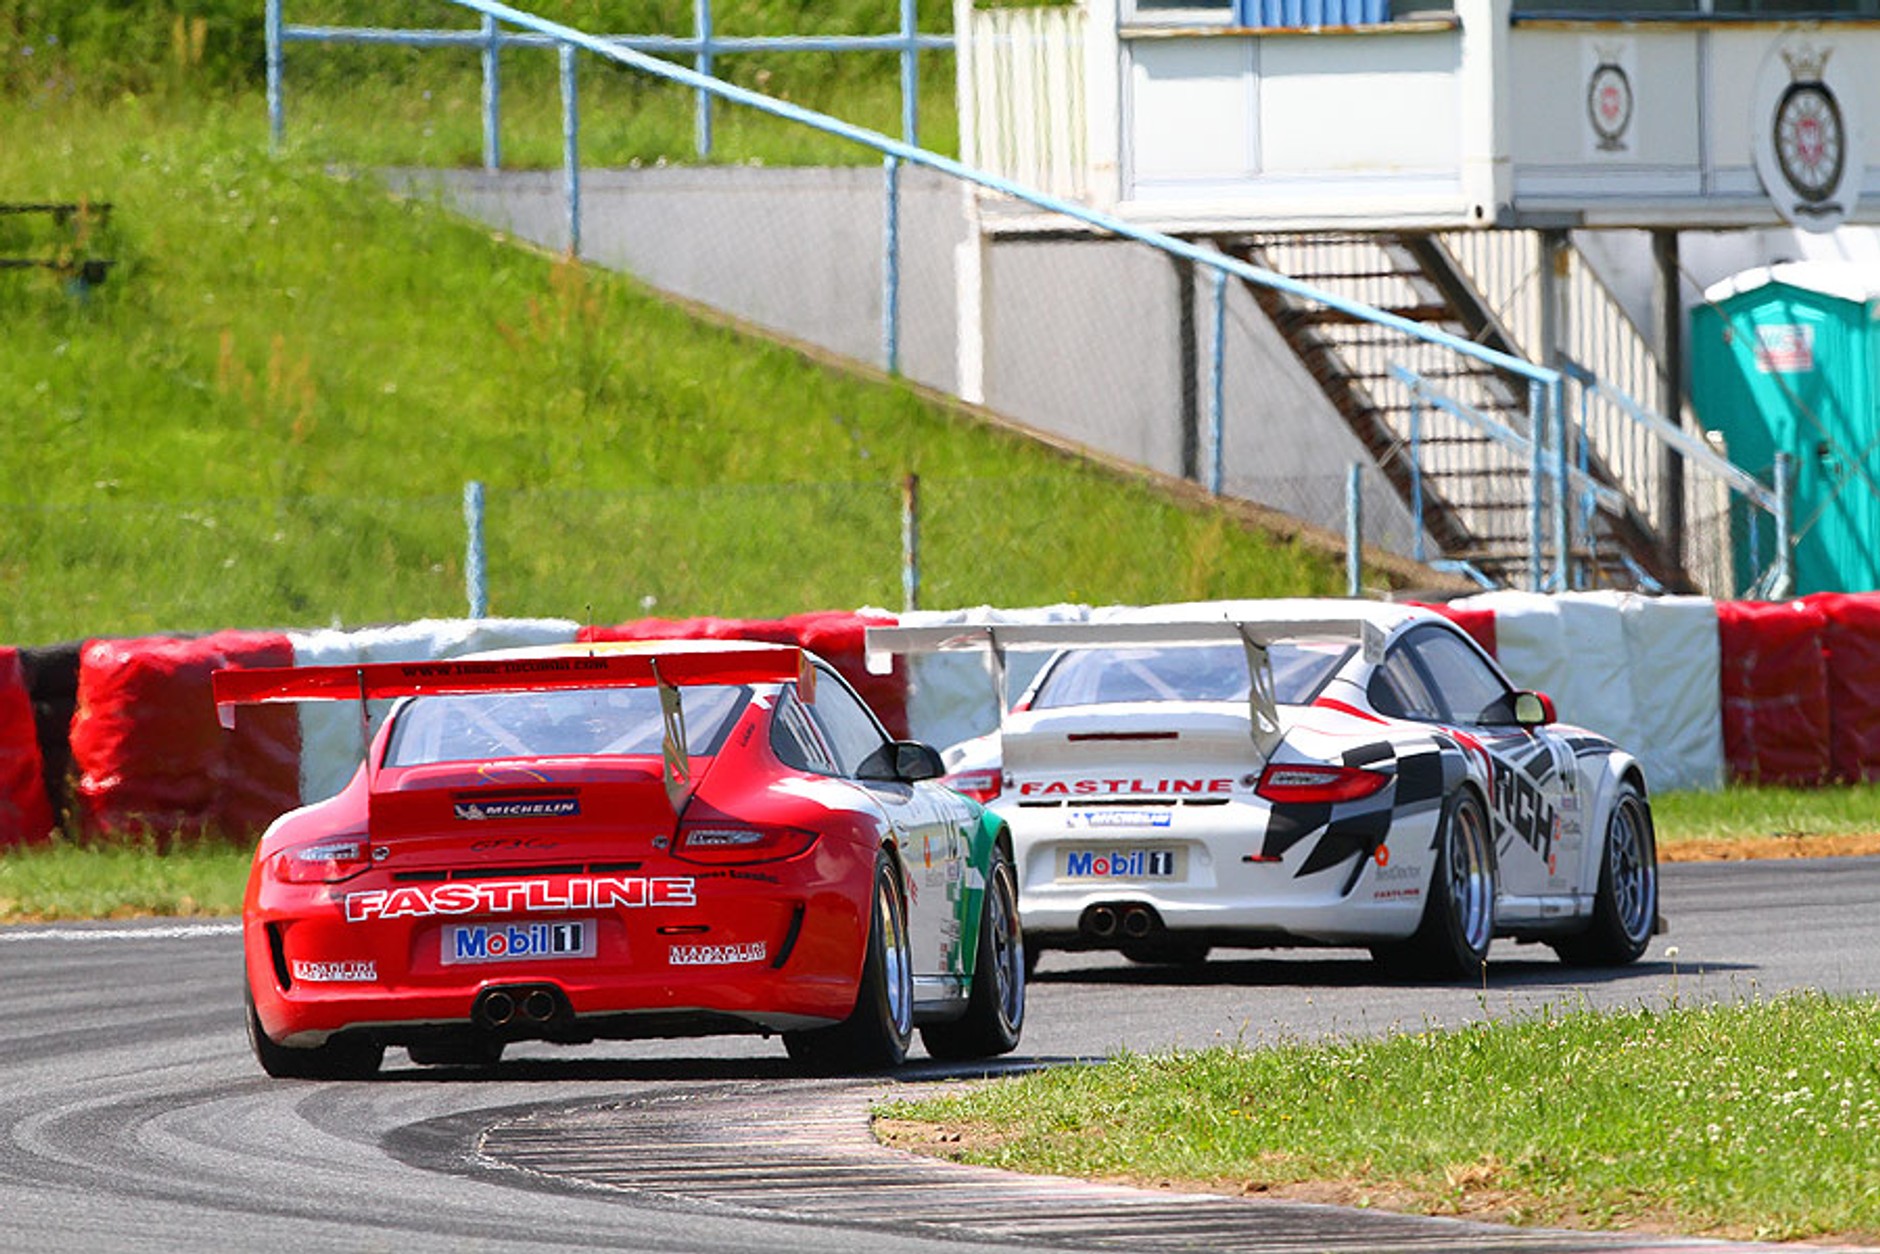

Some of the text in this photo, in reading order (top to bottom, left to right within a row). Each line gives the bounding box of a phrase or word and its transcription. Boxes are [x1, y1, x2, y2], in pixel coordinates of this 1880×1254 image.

[1019, 779, 1234, 796] FASTLINE
[486, 803, 575, 816] MICHELIN
[1067, 851, 1171, 876] Mobil 1
[344, 876, 698, 924] FASTLINE
[455, 924, 580, 958] Mobil 1
